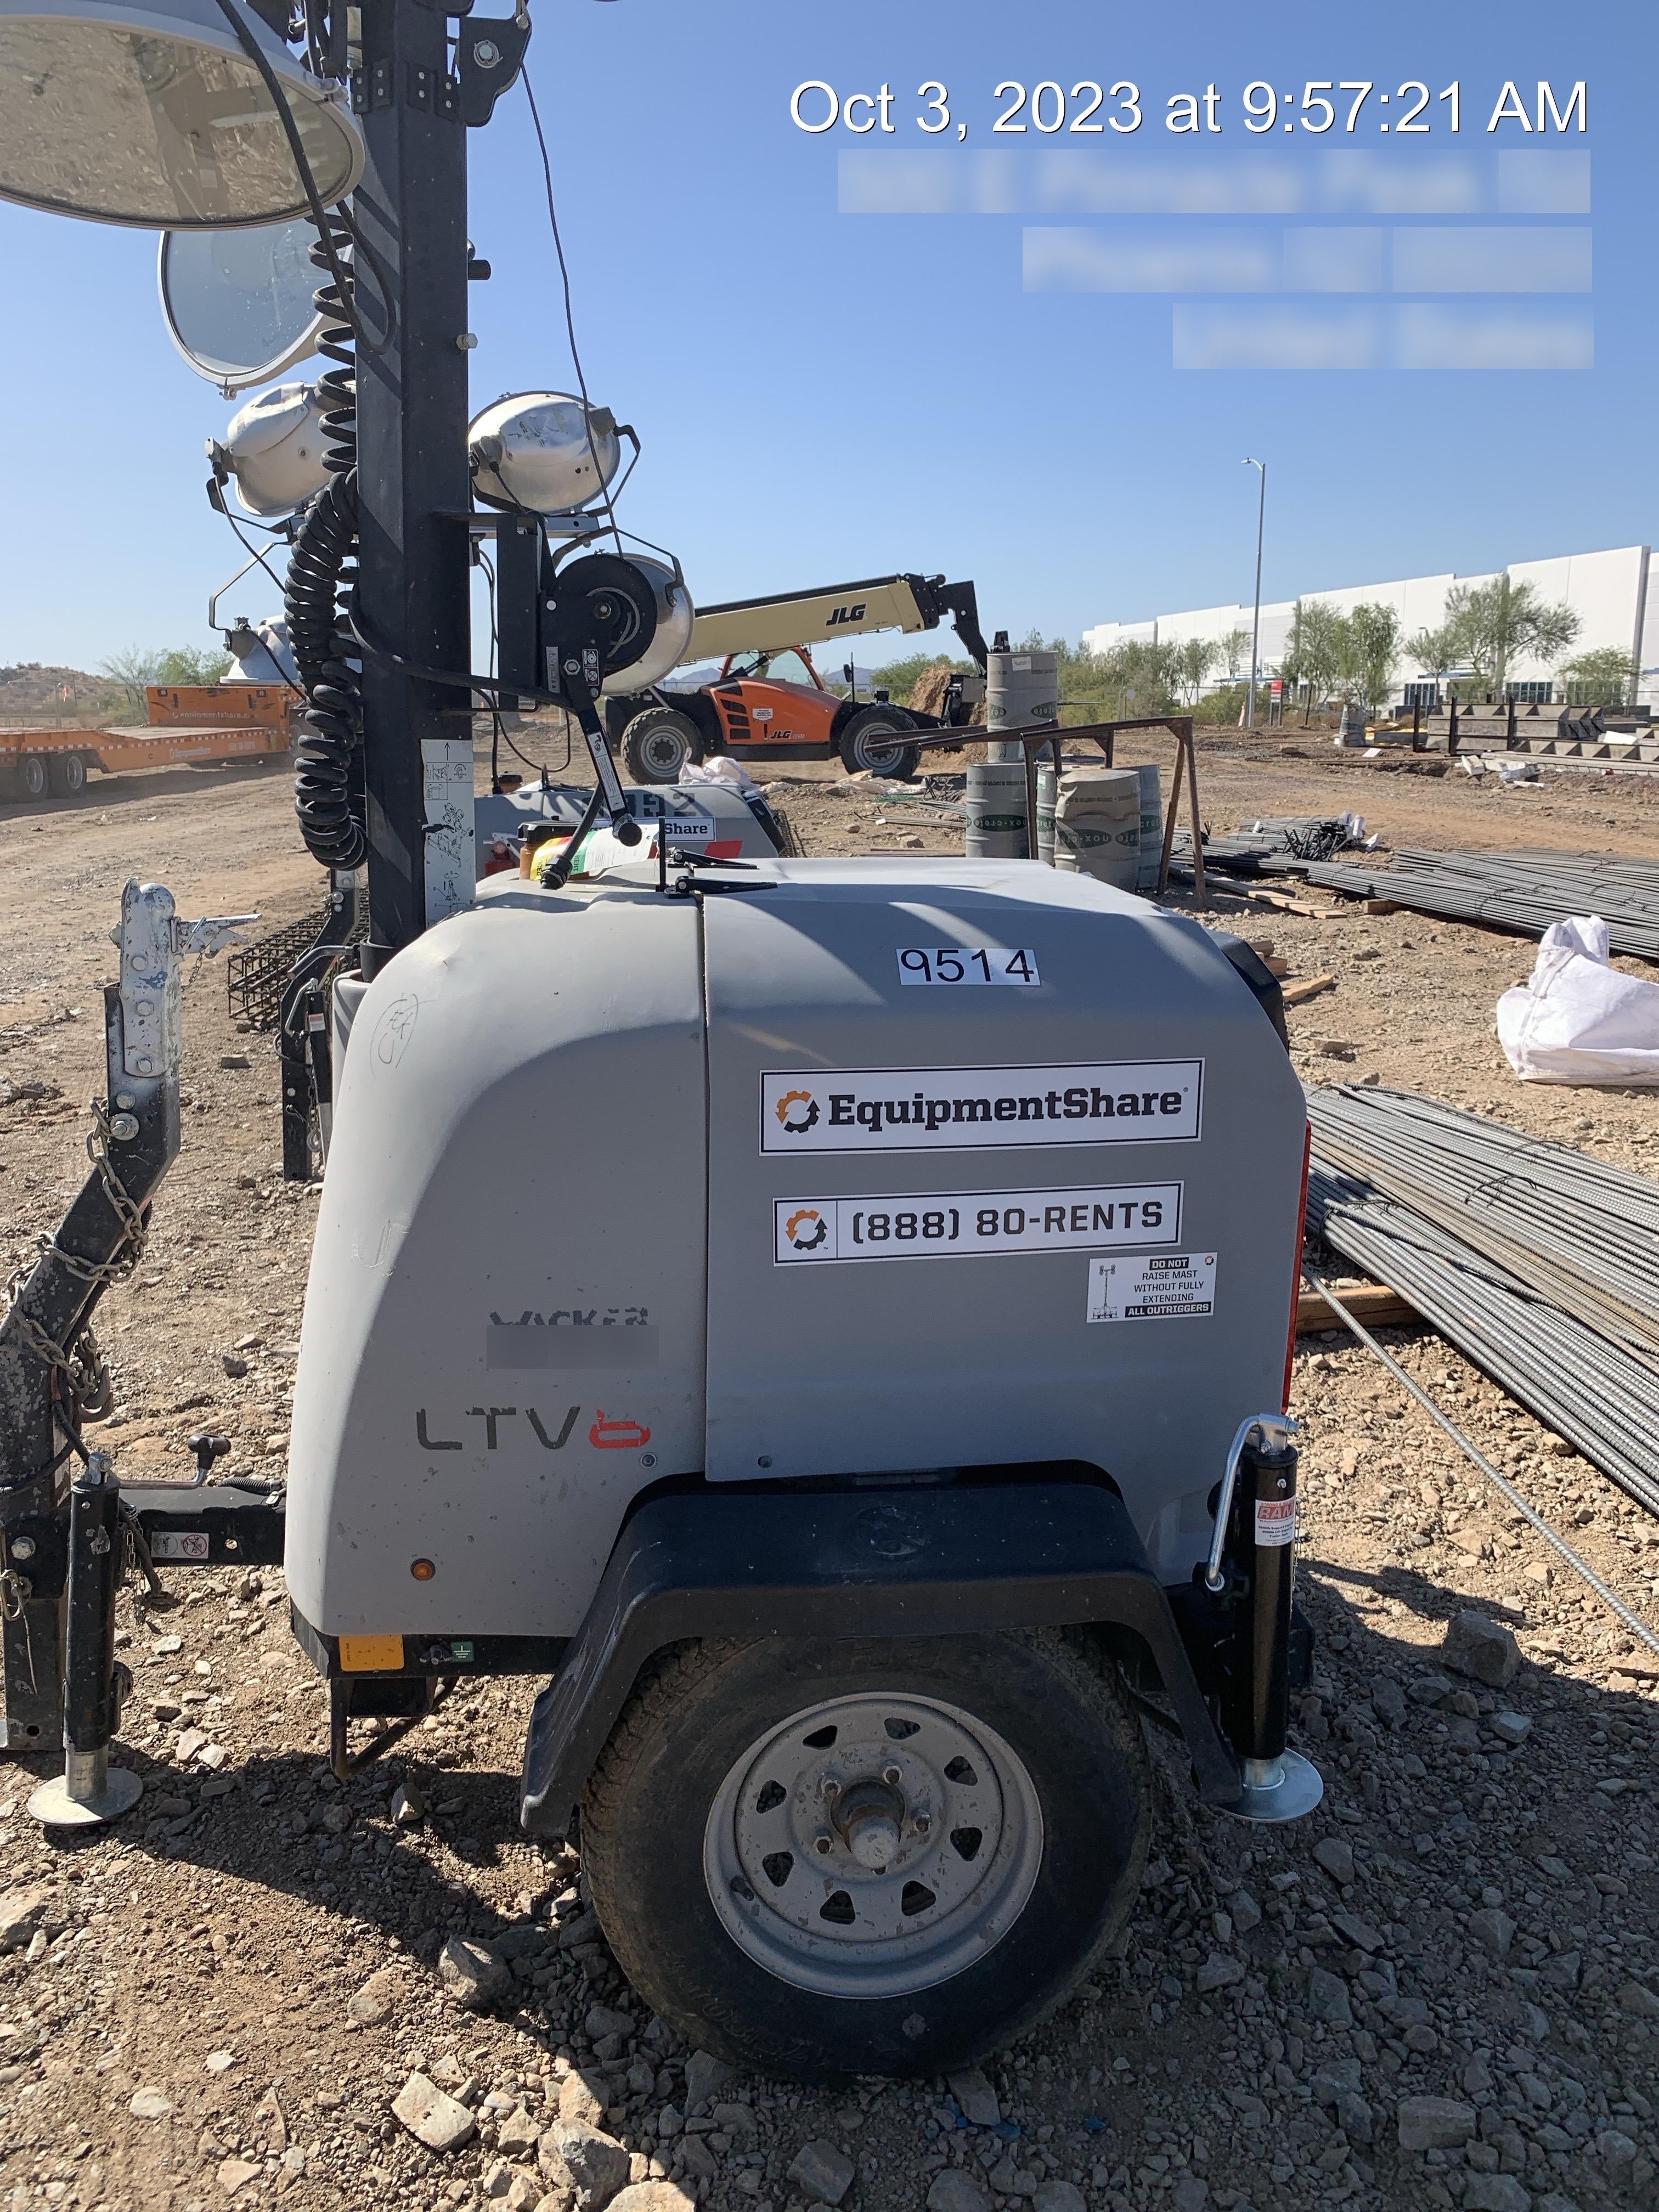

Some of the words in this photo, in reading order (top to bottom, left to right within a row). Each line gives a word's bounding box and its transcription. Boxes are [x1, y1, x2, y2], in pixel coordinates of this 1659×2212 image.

[825, 603, 867, 626] JLG
[770, 730, 792, 739] JLG
[901, 949, 1034, 982] 9514
[828, 1087, 1182, 1132] EquipmentShare
[853, 1209, 959, 1244] (888)
[977, 1201, 1162, 1236] 80-RENTS
[1152, 1260, 1165, 1269] DO
[1167, 1259, 1188, 1268] NOT
[1142, 1272, 1170, 1280] RAISE
[1172, 1270, 1198, 1279] MAST
[1134, 1283, 1176, 1292] WITHOUT
[1179, 1281, 1204, 1290] FULLY
[1143, 1293, 1194, 1304] EXTENDING
[1128, 1306, 1146, 1316] ALL
[1147, 1304, 1209, 1314] OUTRIGGERS
[1259, 1503, 1294, 1519] RAM
